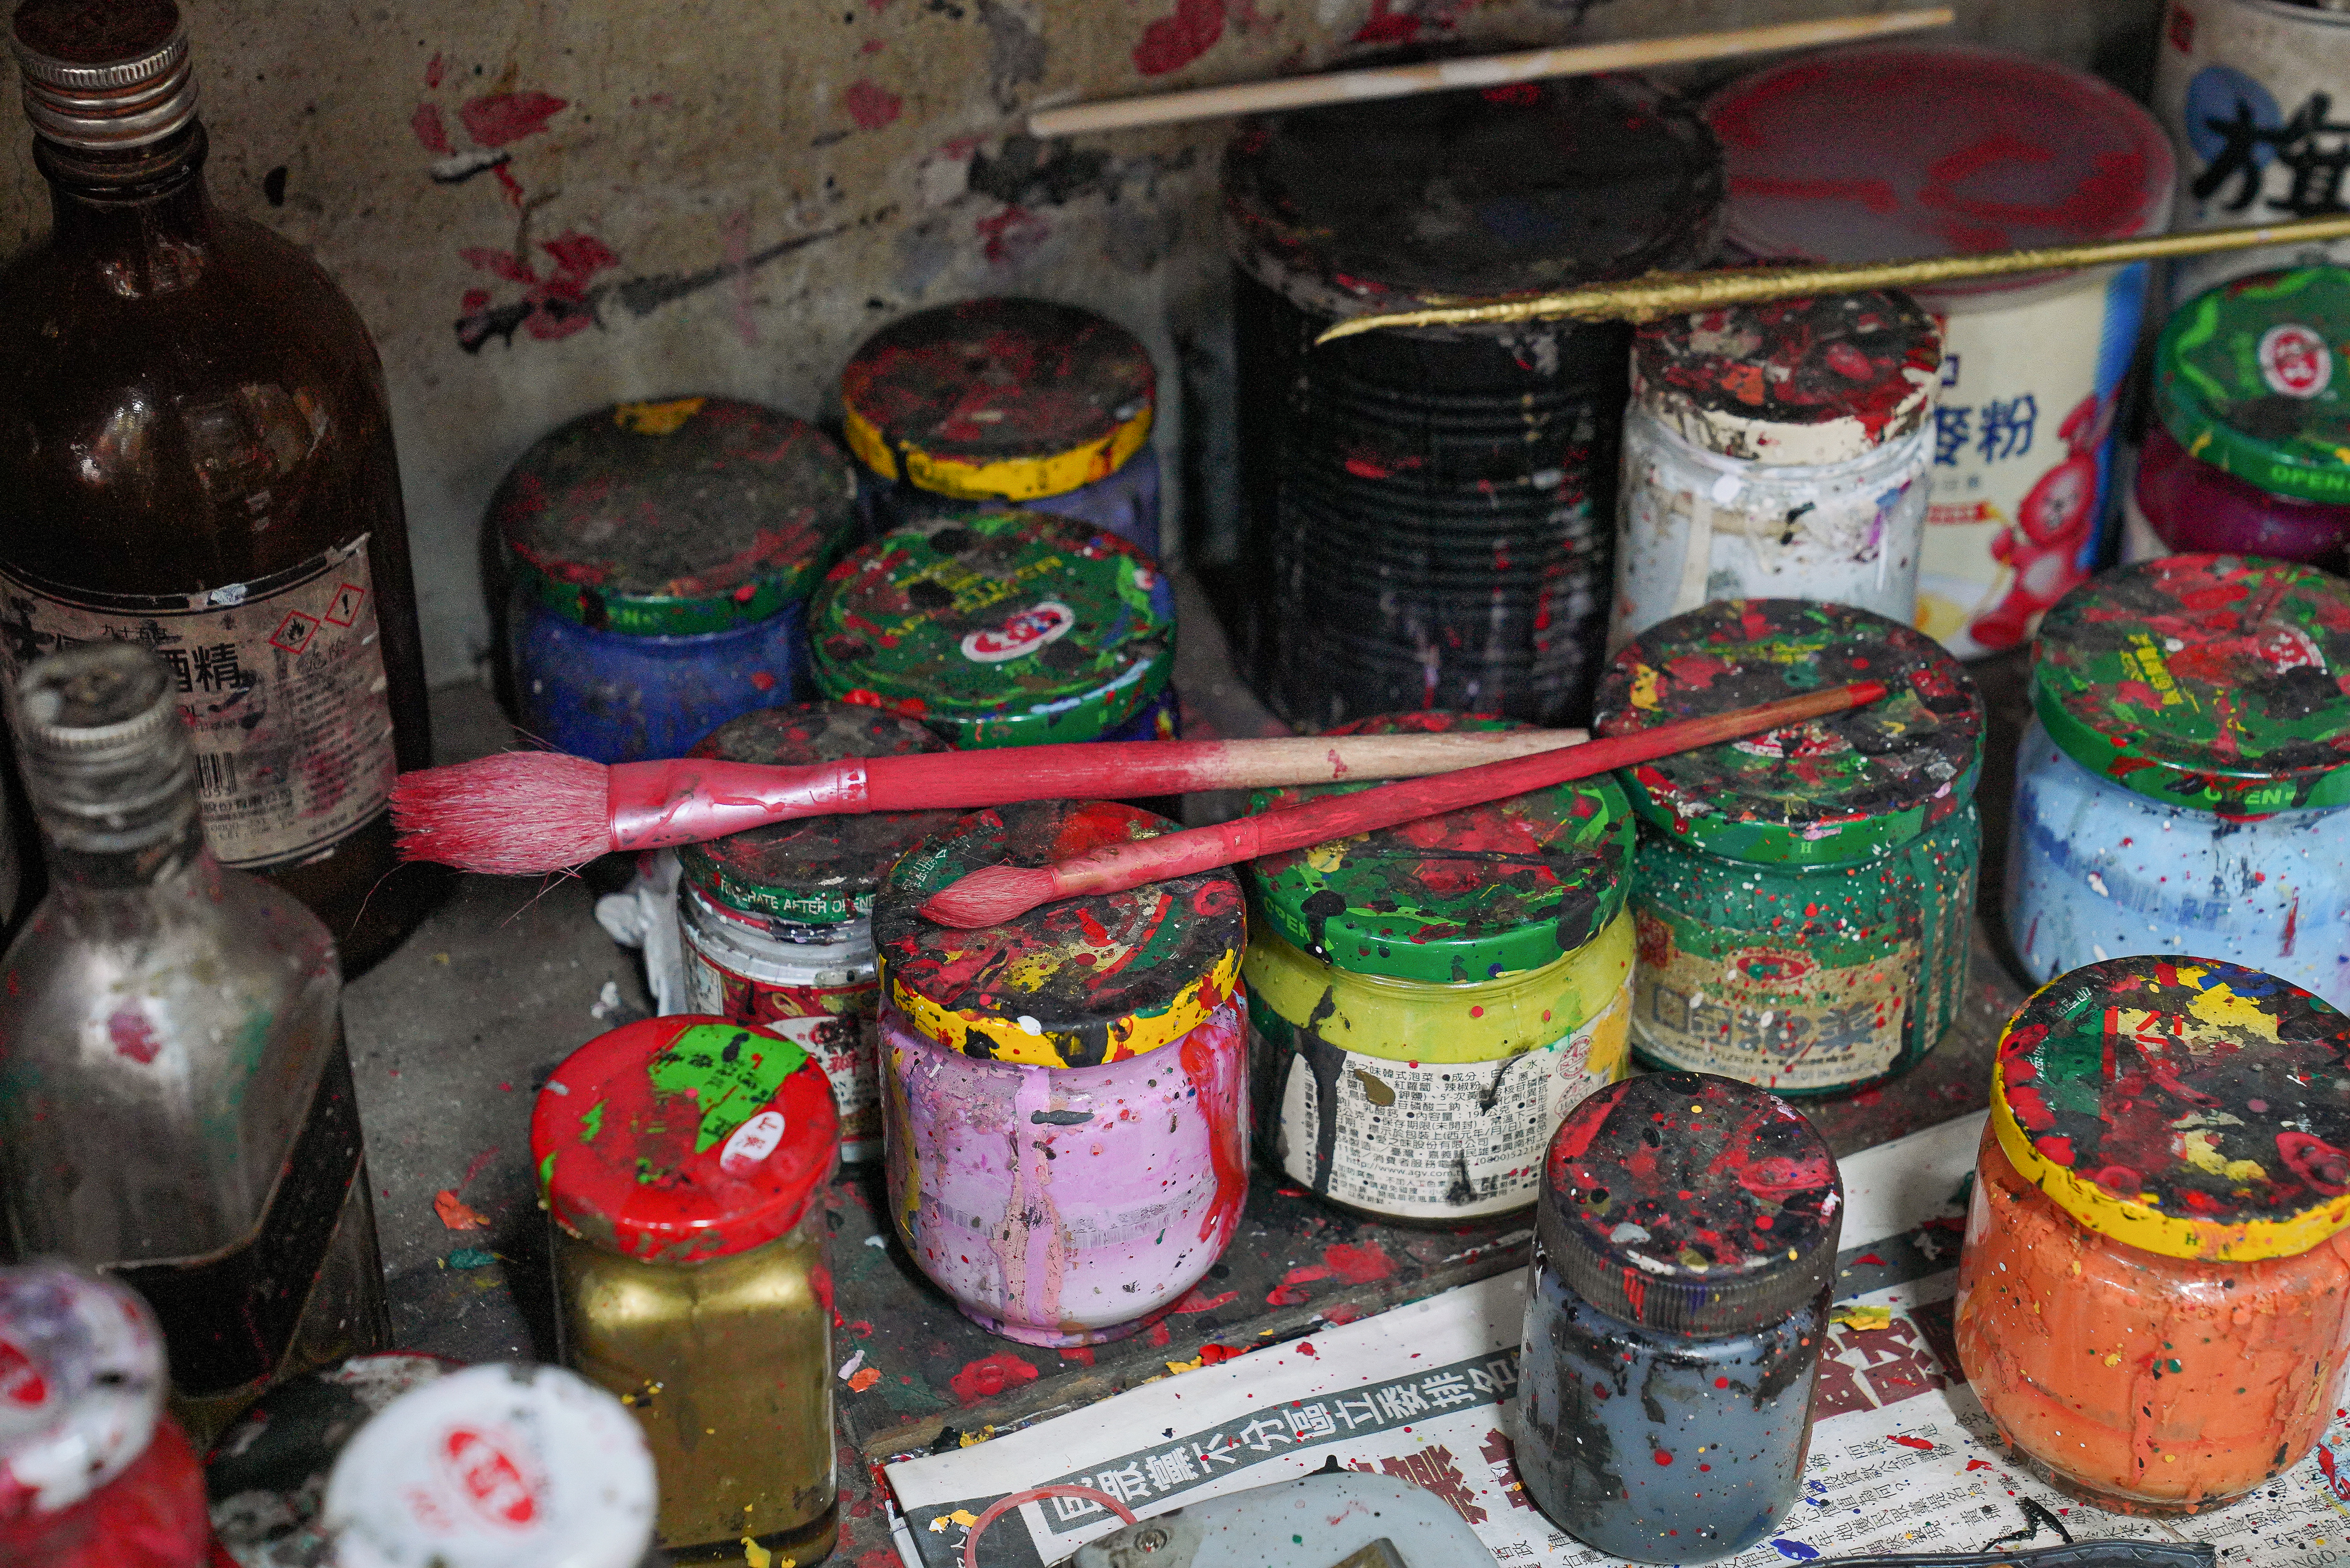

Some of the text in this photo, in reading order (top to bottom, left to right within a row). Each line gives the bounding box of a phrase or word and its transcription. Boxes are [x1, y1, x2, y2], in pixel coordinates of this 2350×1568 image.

[783, 899, 827, 914] AFTER
[1050, 1356, 1519, 1521] 民眾黨不分區立委排名
